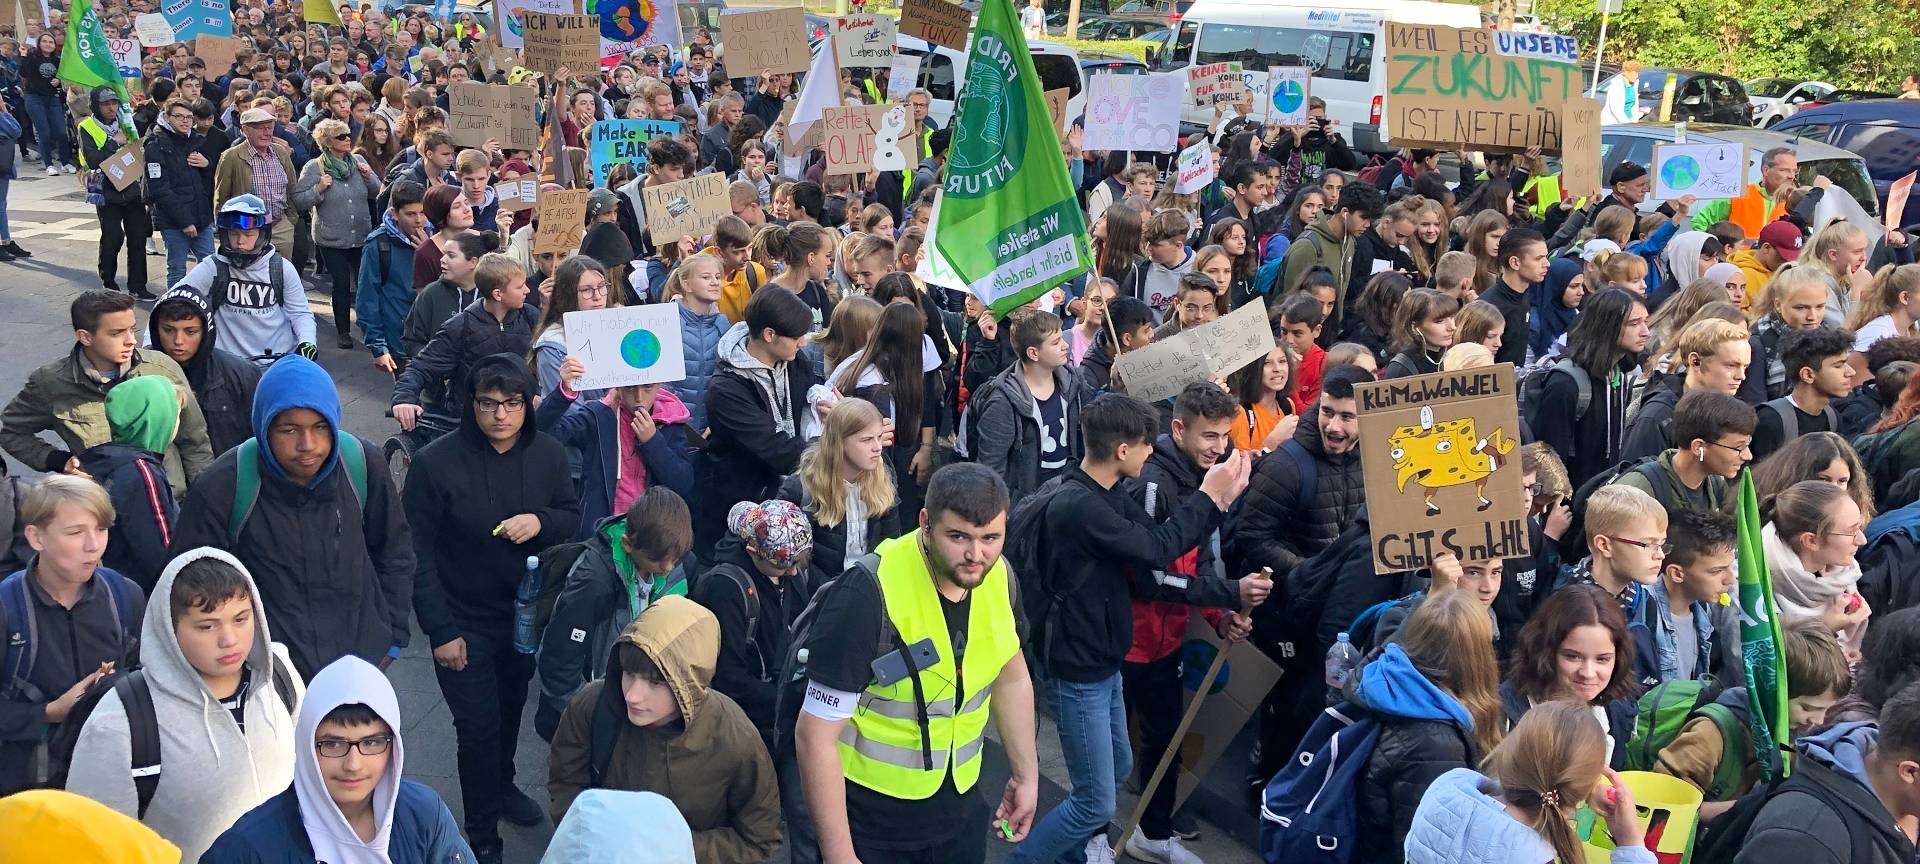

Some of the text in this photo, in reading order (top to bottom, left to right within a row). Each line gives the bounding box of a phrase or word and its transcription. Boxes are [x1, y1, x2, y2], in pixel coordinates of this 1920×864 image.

[172, 17, 193, 33] planet
[525, 13, 600, 30] ICH WILL IM
[731, 12, 794, 32] GLOBAL
[864, 28, 880, 39] statt
[920, 22, 960, 45] TUN!
[1391, 25, 1579, 60] WEIL ES UNSERE
[565, 49, 591, 58] NICHT
[748, 47, 789, 70] NOW!
[525, 56, 541, 69] AUF
[561, 61, 599, 73] STRASSE
[1191, 63, 1228, 81] KEINE
[1217, 73, 1243, 83] KOHLE
[1219, 81, 1232, 89] DIE
[1391, 52, 1582, 104] ZUKUNFT
[453, 85, 487, 107] Schule
[451, 110, 492, 130] Zukunft
[825, 107, 871, 130] Rettet
[1454, 110, 1504, 143] NET
[504, 127, 537, 145] HEUTE
[599, 122, 637, 141] Make
[614, 141, 648, 158] EAR
[828, 133, 874, 165] OLAF
[687, 175, 723, 201] TREES
[544, 191, 587, 206] NOT READY TO
[544, 207, 577, 222] BE A FISH
[578, 339, 594, 362] 1
[1122, 358, 1164, 381] Rettet
[1171, 351, 1187, 365] die
[1278, 641, 1296, 658] 19
[807, 686, 840, 708] ORDNER
